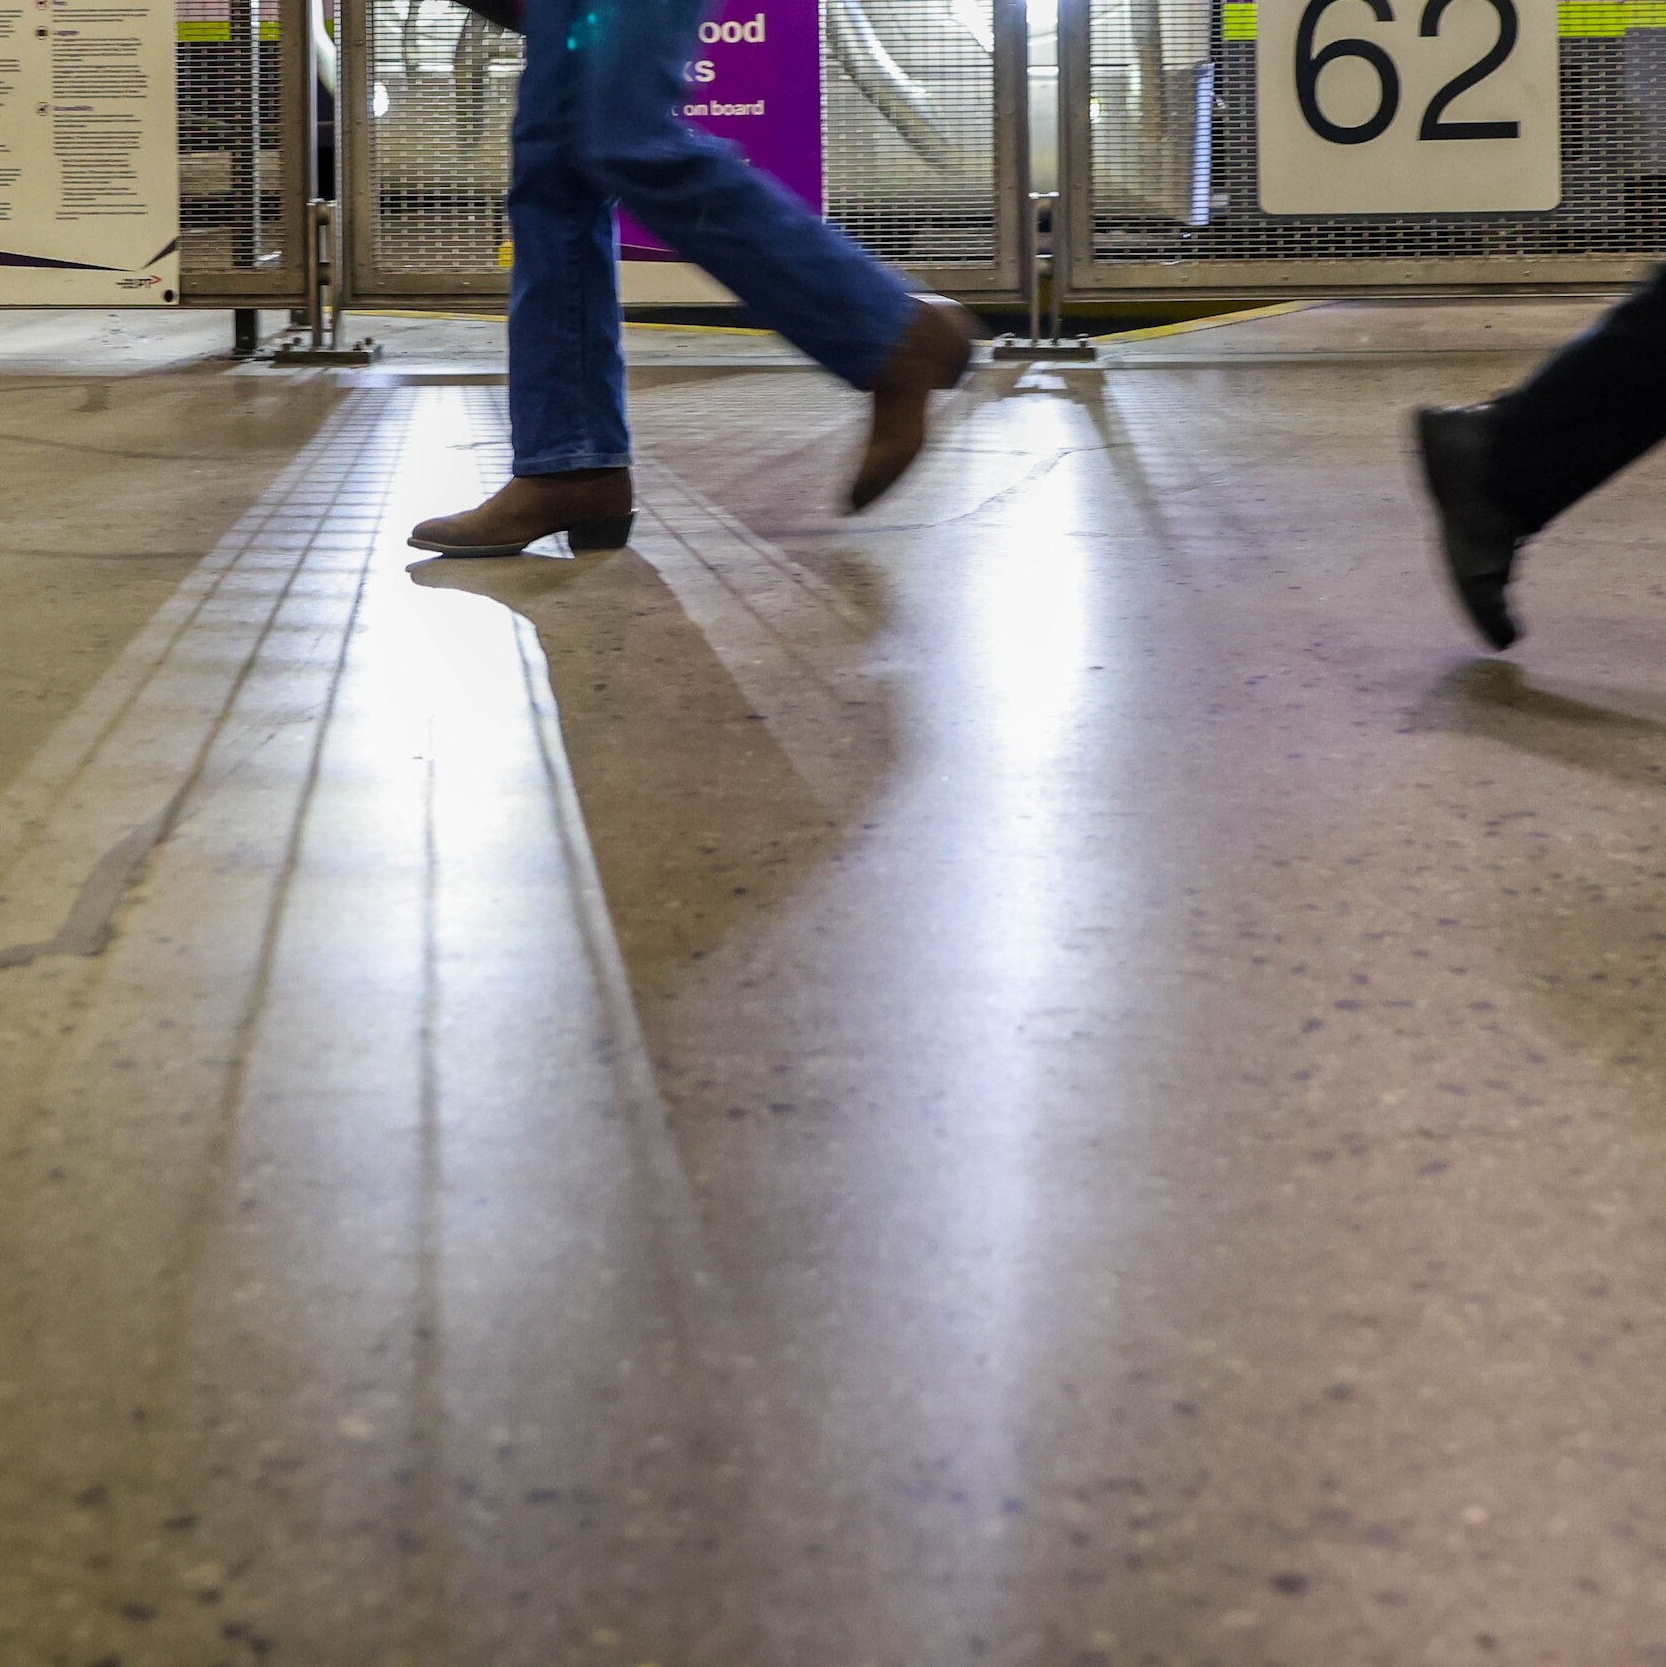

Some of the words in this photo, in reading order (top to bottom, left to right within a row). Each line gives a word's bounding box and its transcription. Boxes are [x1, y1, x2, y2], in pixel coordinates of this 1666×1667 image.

[697, 13, 766, 43] ood
[683, 104, 708, 116] on
[709, 100, 765, 116] board
